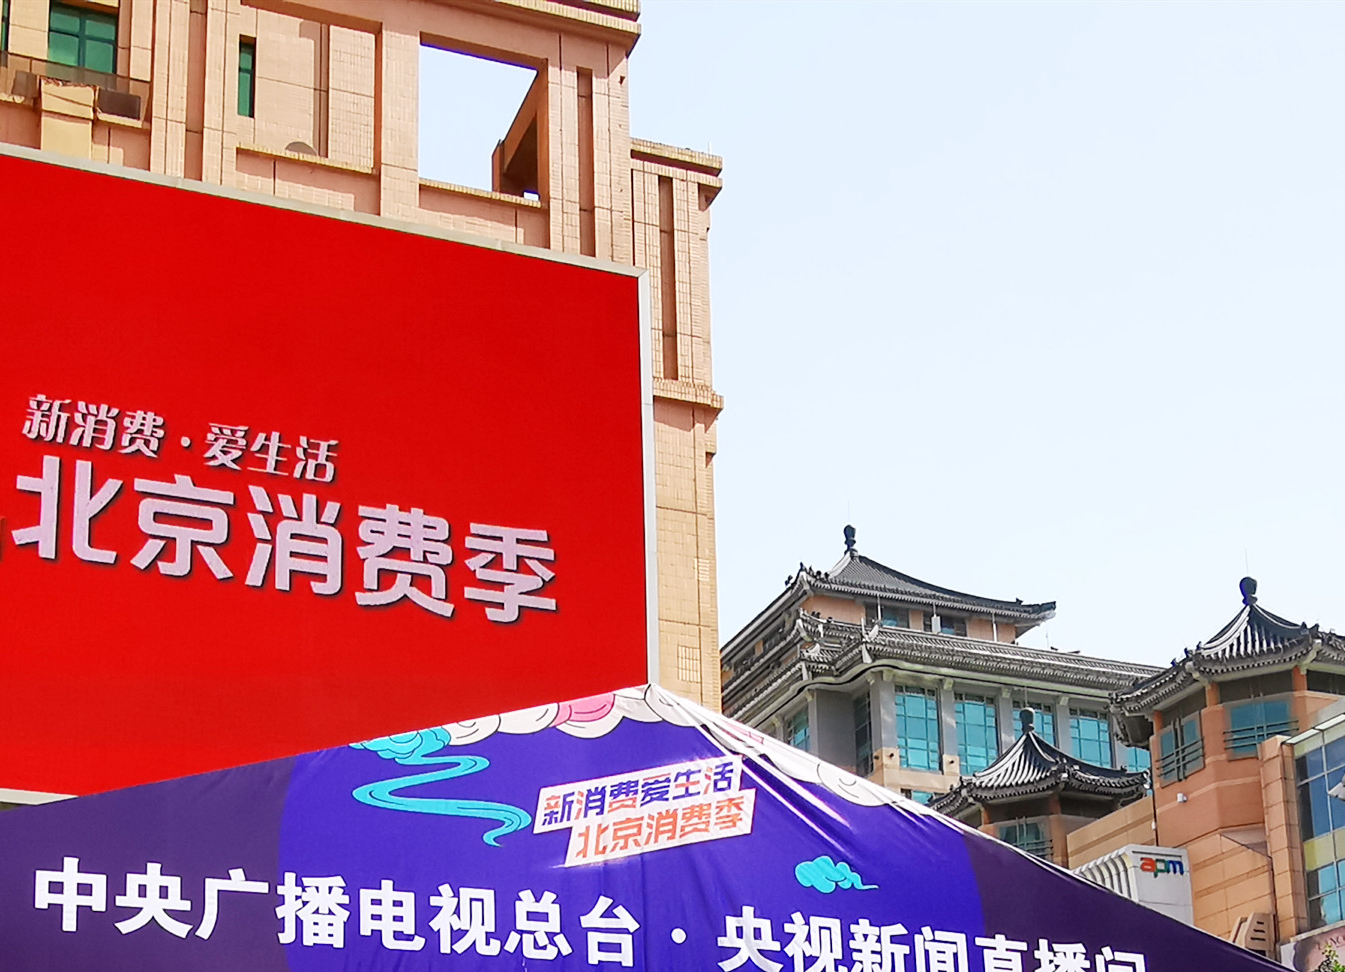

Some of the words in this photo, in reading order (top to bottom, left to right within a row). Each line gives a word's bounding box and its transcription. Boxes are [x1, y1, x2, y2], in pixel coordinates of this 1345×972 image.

[12, 455, 558, 623] 北京消费季
[542, 762, 734, 827] 新消费爱生活
[575, 796, 745, 859] 北京消费季
[1140, 857, 1184, 878] apm
